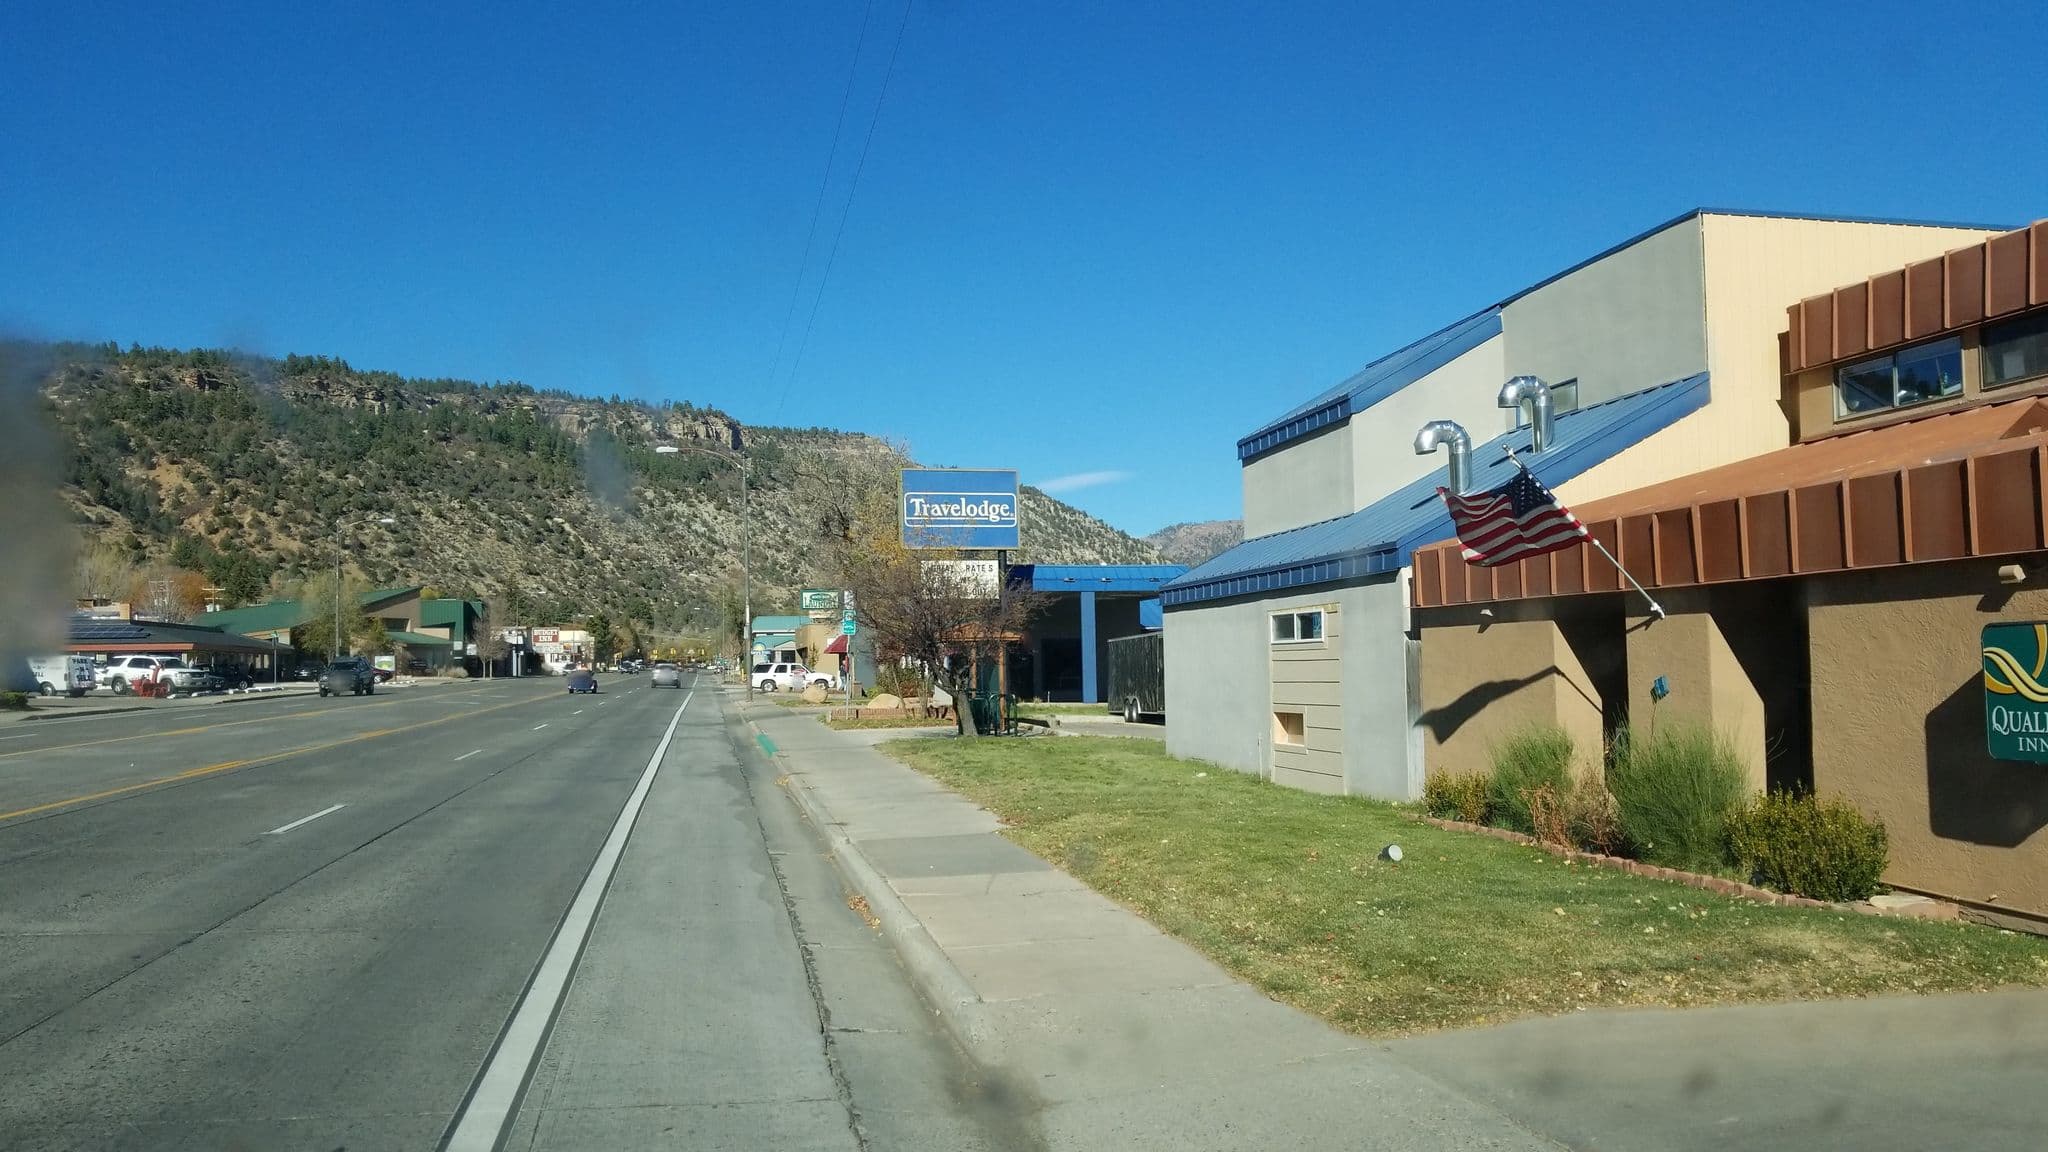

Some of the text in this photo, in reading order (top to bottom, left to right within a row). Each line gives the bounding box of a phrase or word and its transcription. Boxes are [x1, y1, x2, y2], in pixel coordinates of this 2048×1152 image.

[910, 497, 1010, 522] Travelodge
[965, 564, 994, 573] RATES
[2018, 737, 2048, 753] INN
